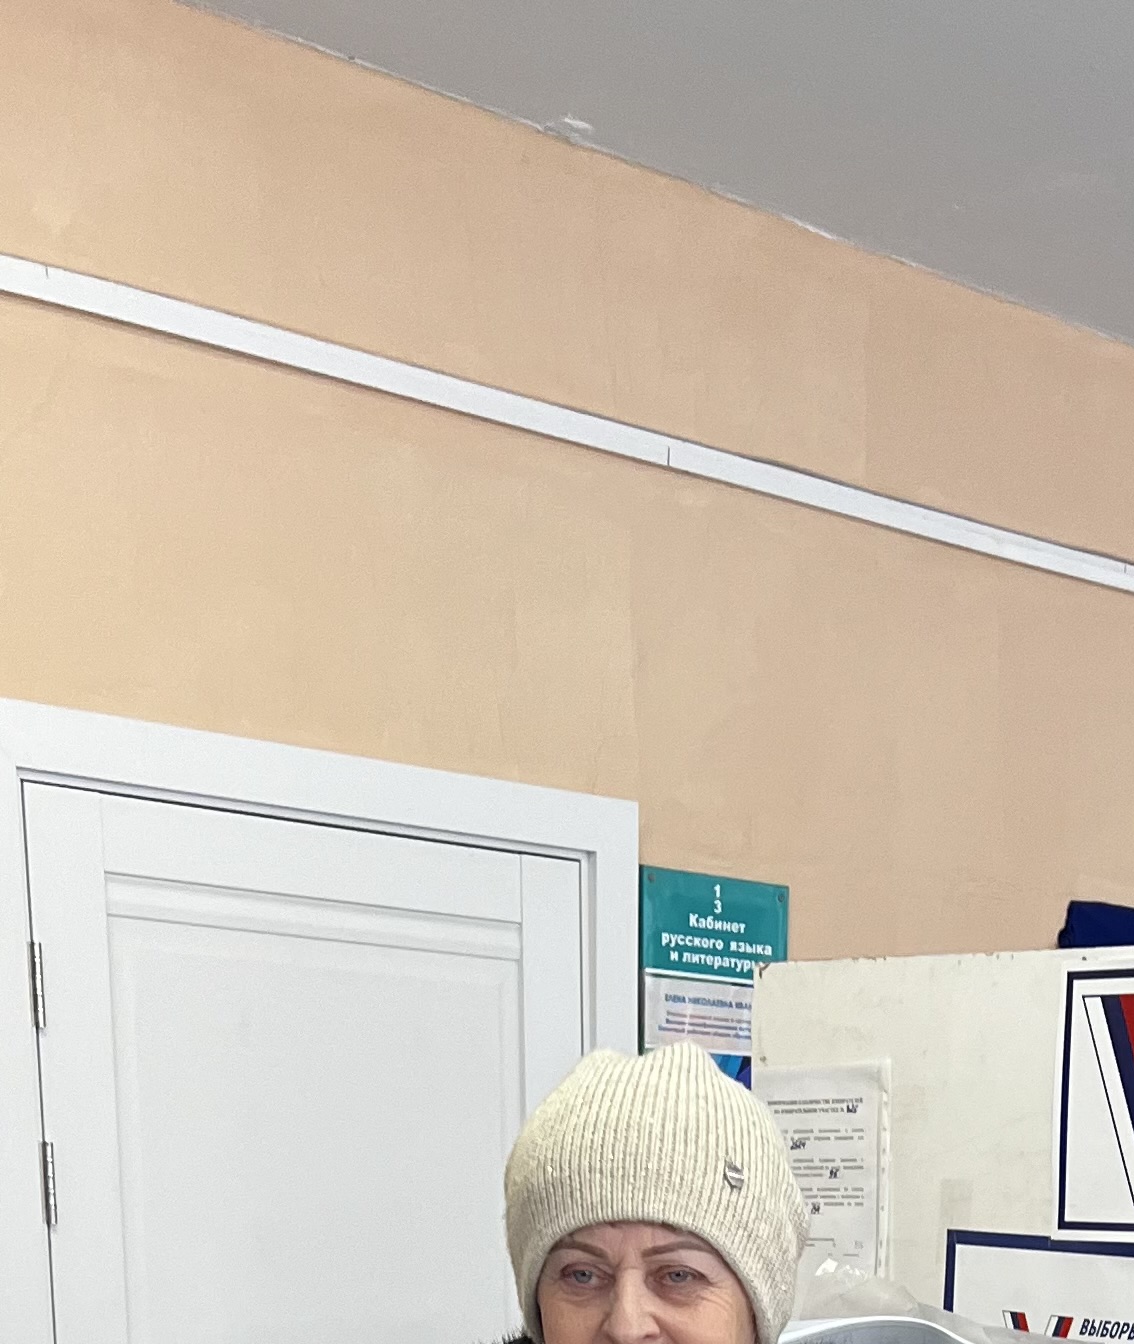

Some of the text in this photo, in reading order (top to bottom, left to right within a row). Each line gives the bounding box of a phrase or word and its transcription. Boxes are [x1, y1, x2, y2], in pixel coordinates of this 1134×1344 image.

[713, 883, 721, 898] 1
[713, 899, 722, 914] 3
[688, 912, 746, 934] Кабинет
[661, 931, 773, 956] русского языка
[669, 950, 679, 961] и
